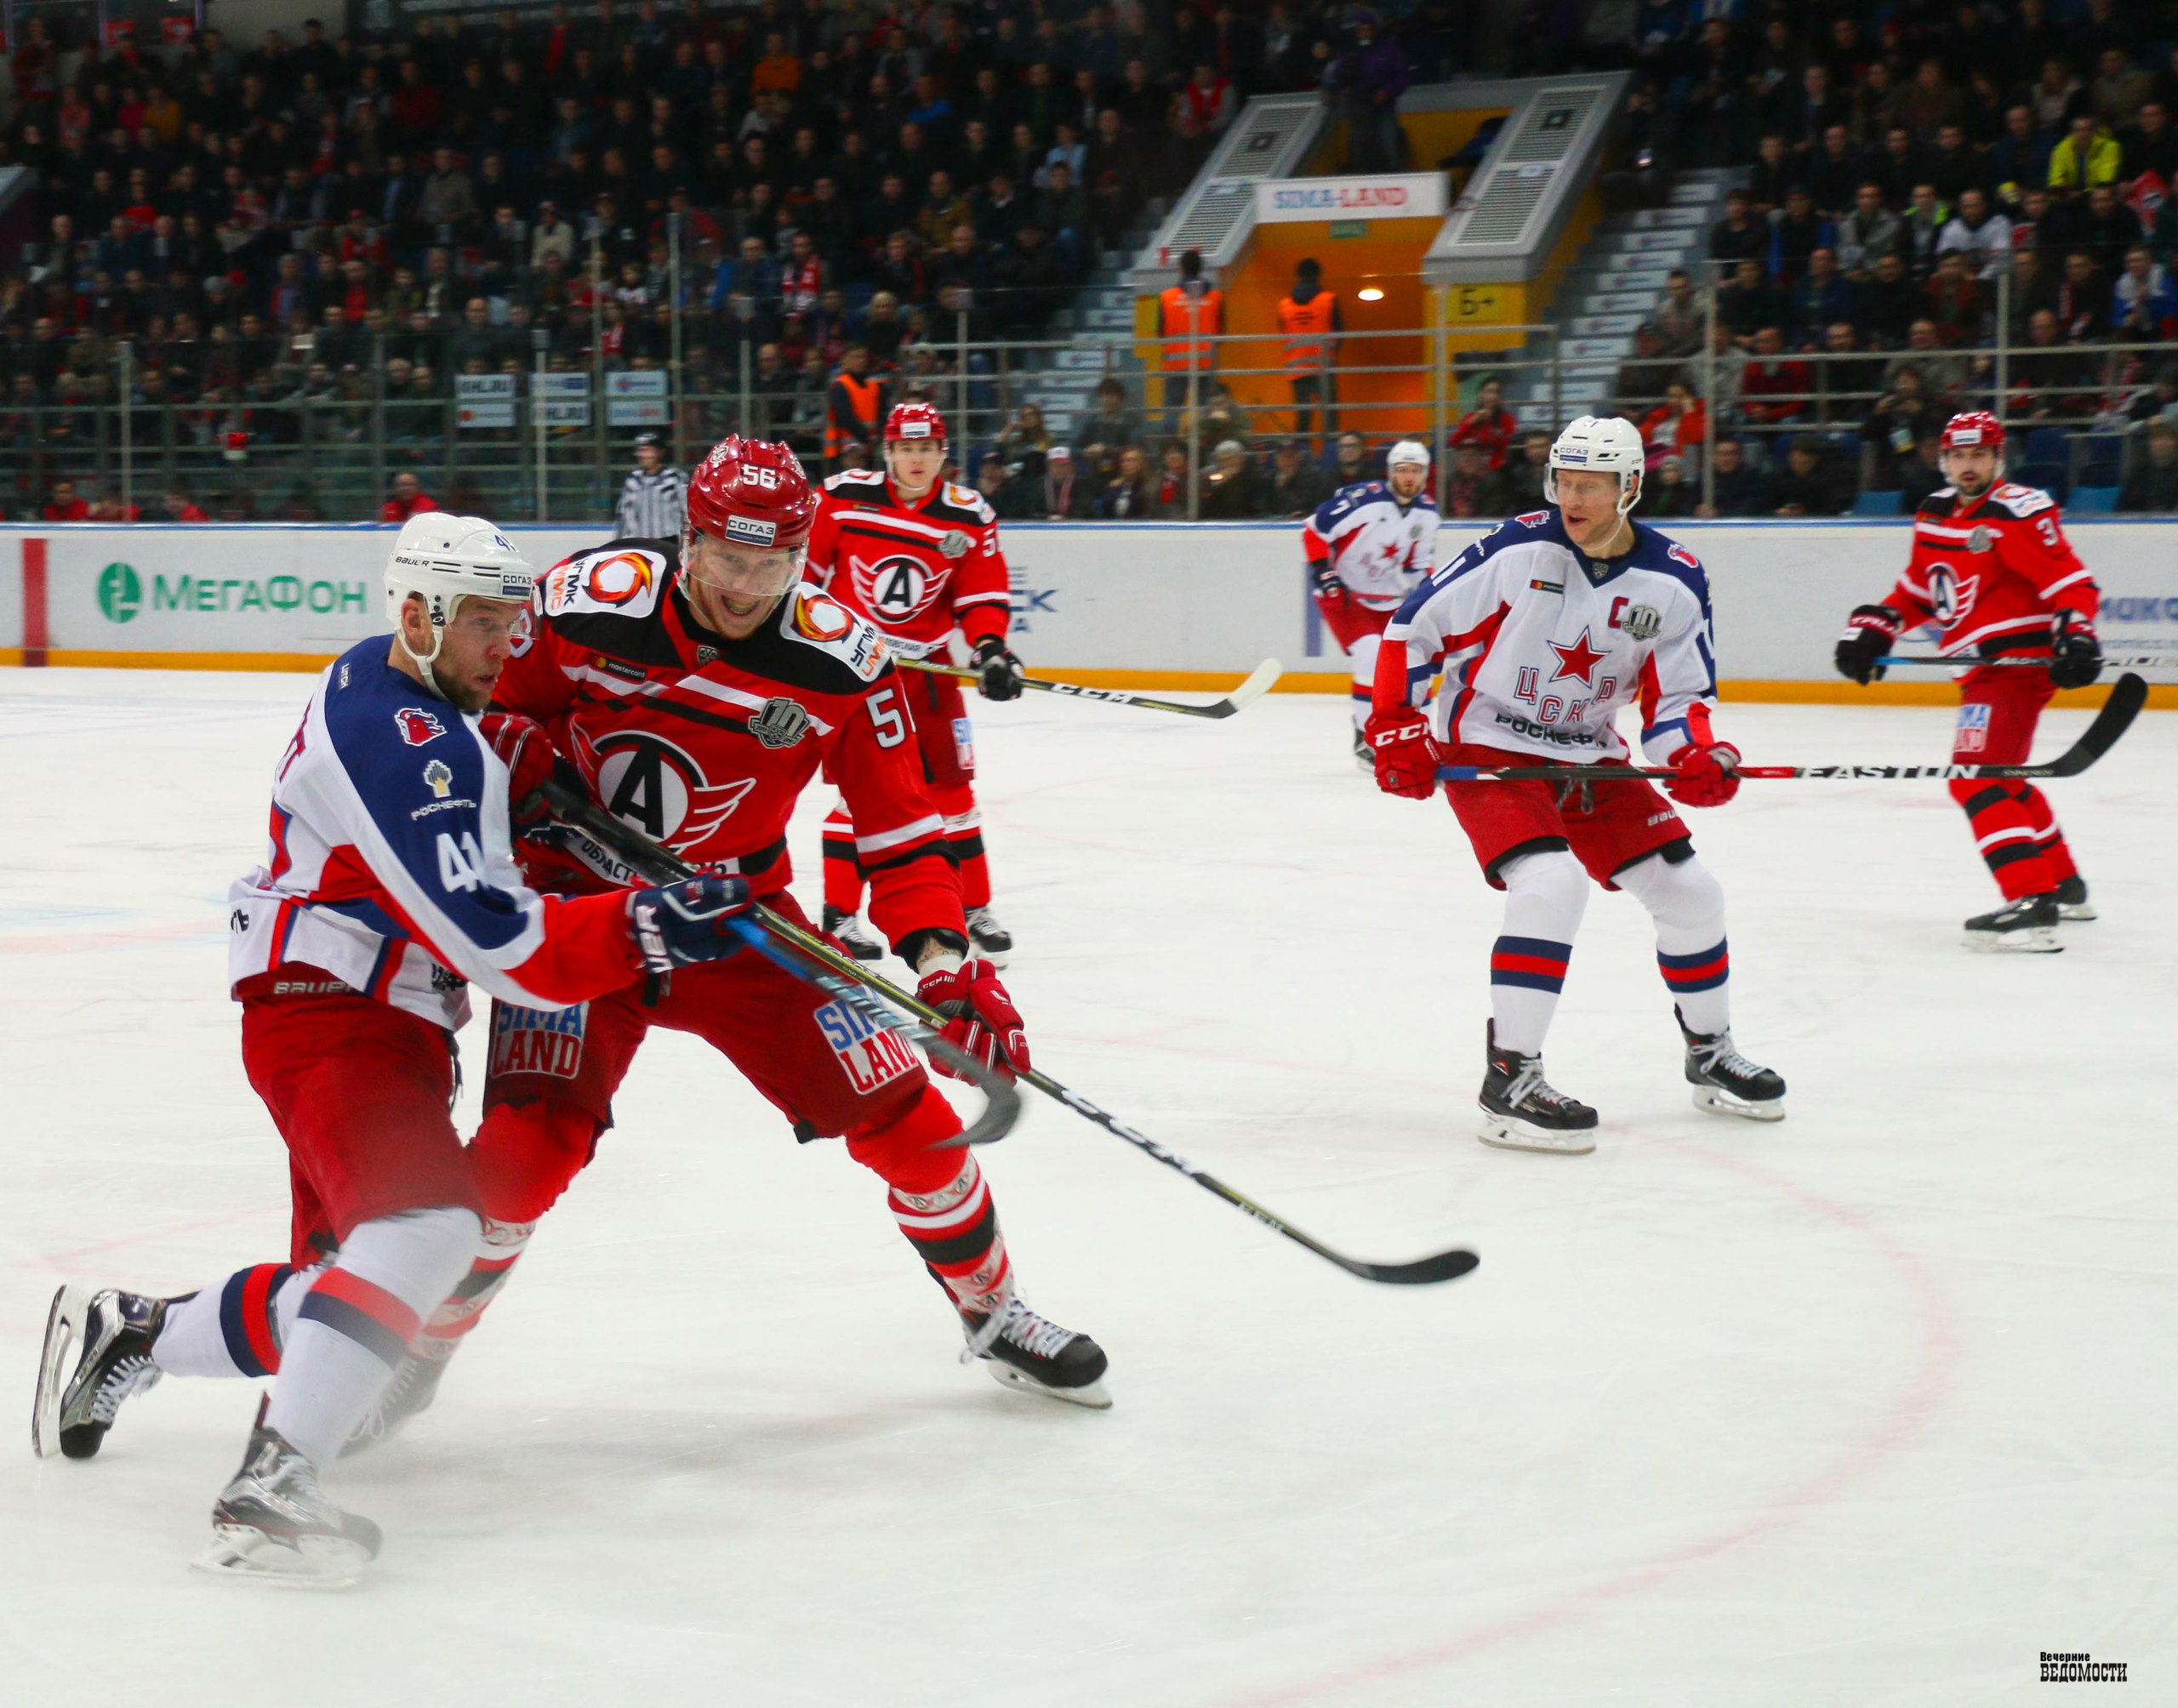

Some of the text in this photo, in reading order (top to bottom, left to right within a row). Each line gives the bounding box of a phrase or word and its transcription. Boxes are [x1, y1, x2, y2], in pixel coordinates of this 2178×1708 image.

[742, 464, 777, 490] 56
[728, 520, 774, 536] СОГАЗ
[503, 575, 533, 585] СОГАЗ
[607, 662, 646, 679] mastercard
[1052, 682, 1134, 704] CCM
[1804, 765, 1981, 779] EASTON
[411, 799, 477, 822] РОСНЕФТЬ
[436, 831, 489, 893] 41
[922, 976, 943, 989] CCM
[493, 1028, 581, 1077] LAND
